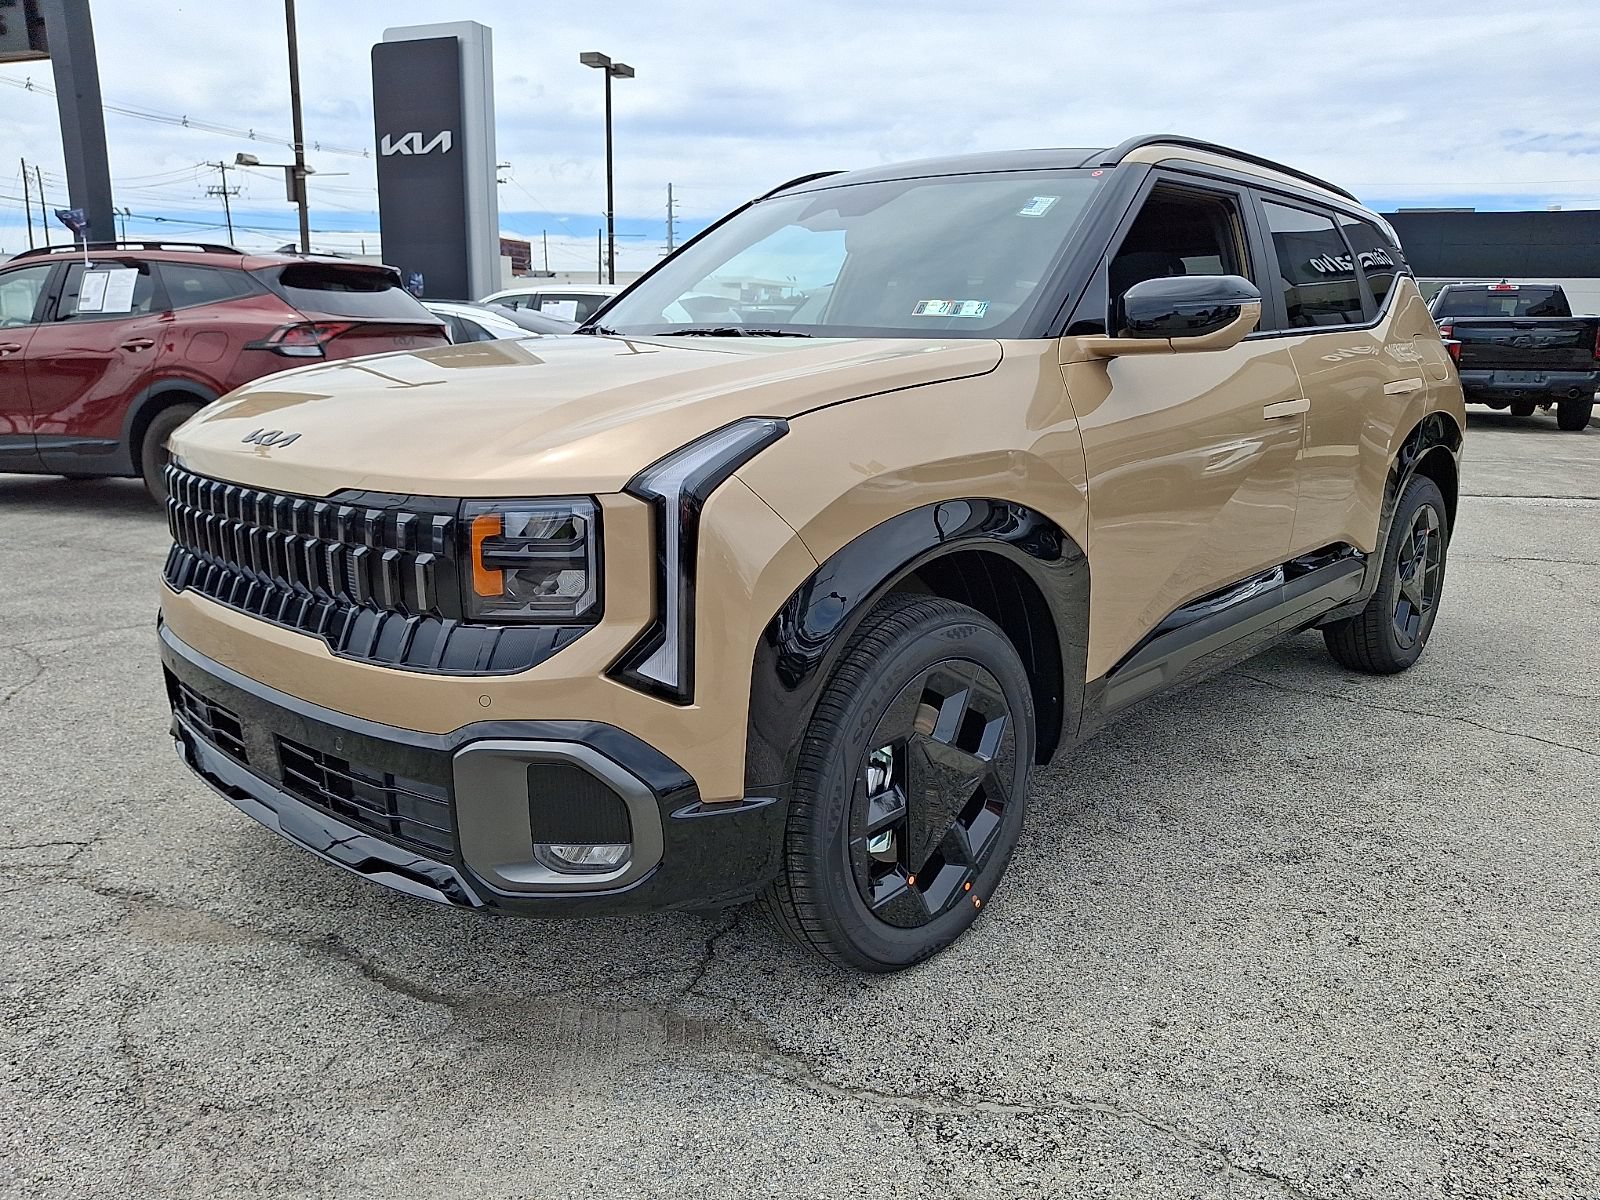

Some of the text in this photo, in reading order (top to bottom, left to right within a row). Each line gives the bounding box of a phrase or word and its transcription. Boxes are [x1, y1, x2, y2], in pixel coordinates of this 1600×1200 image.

[381, 130, 452, 155] KIA
[241, 428, 302, 449] KIA
[852, 664, 905, 745] SOLUS
